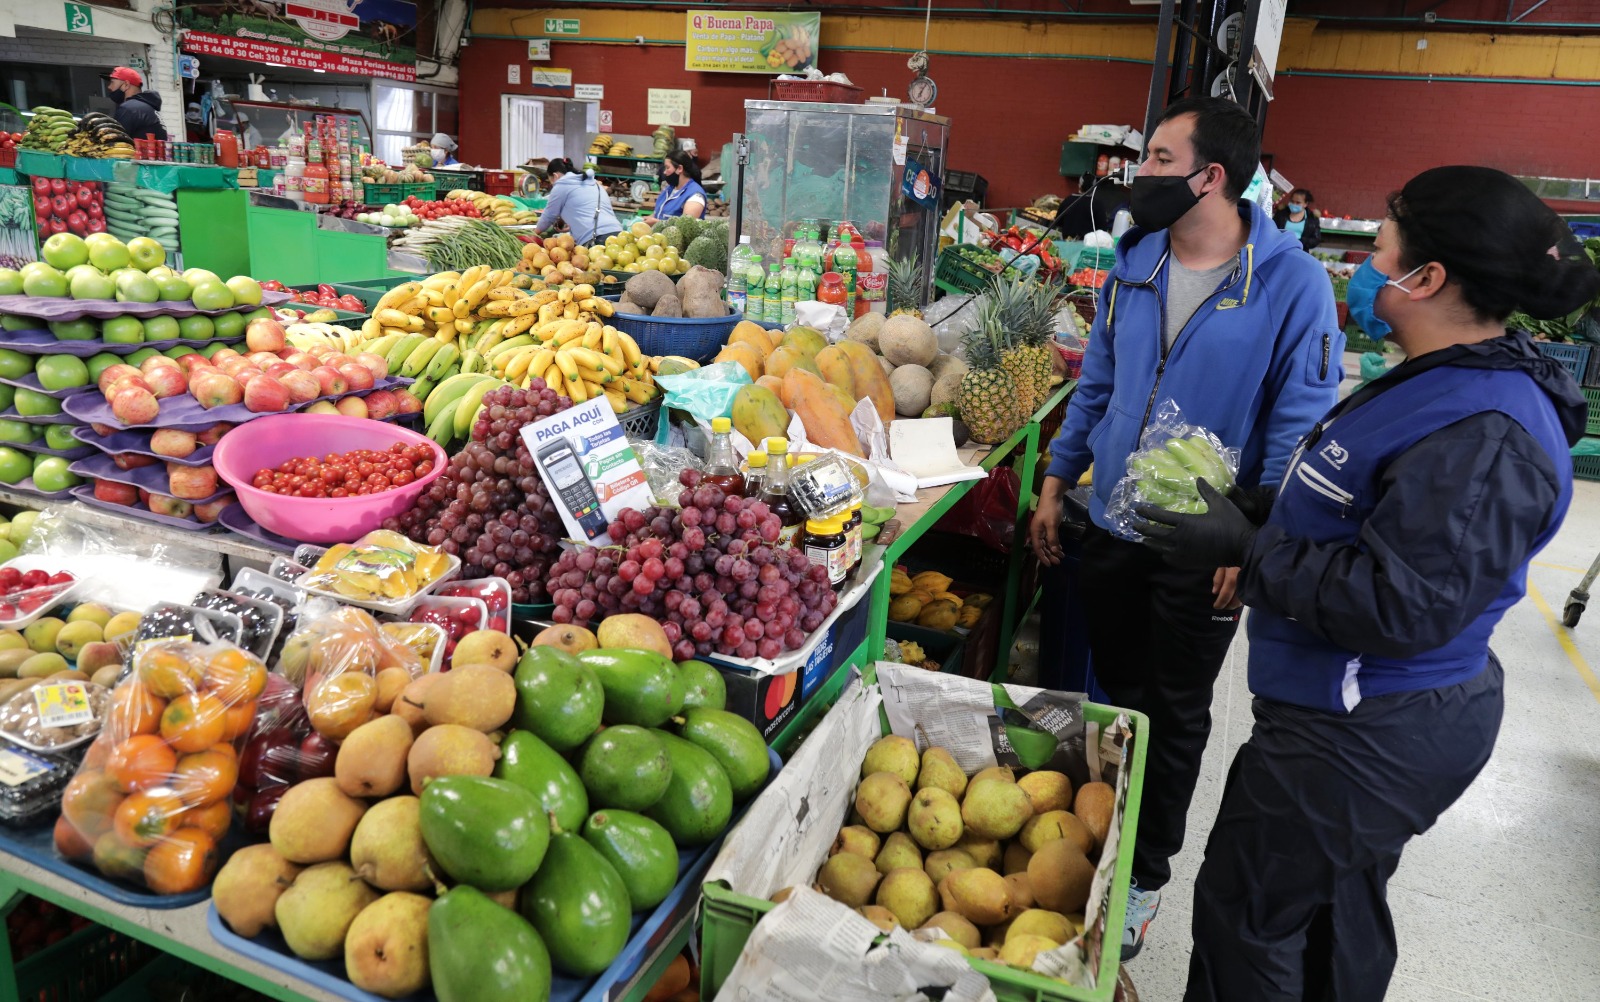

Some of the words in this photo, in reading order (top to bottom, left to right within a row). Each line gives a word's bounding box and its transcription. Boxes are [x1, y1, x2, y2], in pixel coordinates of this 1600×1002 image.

[692, 32, 708, 40] Venta
[720, 33, 735, 41] Papa
[184, 32, 219, 44] Ventas
[233, 40, 249, 49] por
[250, 42, 279, 54] mayor
[283, 48, 289, 57] y
[290, 49, 299, 57] al
[300, 50, 322, 60] detal
[720, 46, 724, 54] y
[725, 45, 738, 54] algo
[185, 43, 202, 52] Tel:
[203, 44, 210, 52] 5
[211, 45, 223, 54] 44
[224, 47, 235, 56] 06
[236, 49, 247, 57] 30
[248, 50, 264, 60] Cel:
[266, 53, 280, 63] 310
[281, 55, 296, 64] 581
[297, 58, 307, 66] 53
[322, 62, 336, 70] 316
[342, 56, 363, 67] Plaza
[363, 59, 386, 70] Ferias
[387, 64, 406, 73] Local
[536, 420, 571, 441] PAGA
[572, 404, 602, 434] AQUÍ
[590, 436, 611, 449] Tarjetas
[601, 458, 625, 471] Contacto
[629, 478, 639, 487] QR
[805, 659, 815, 676] LAS
[763, 700, 795, 737] mastercard
